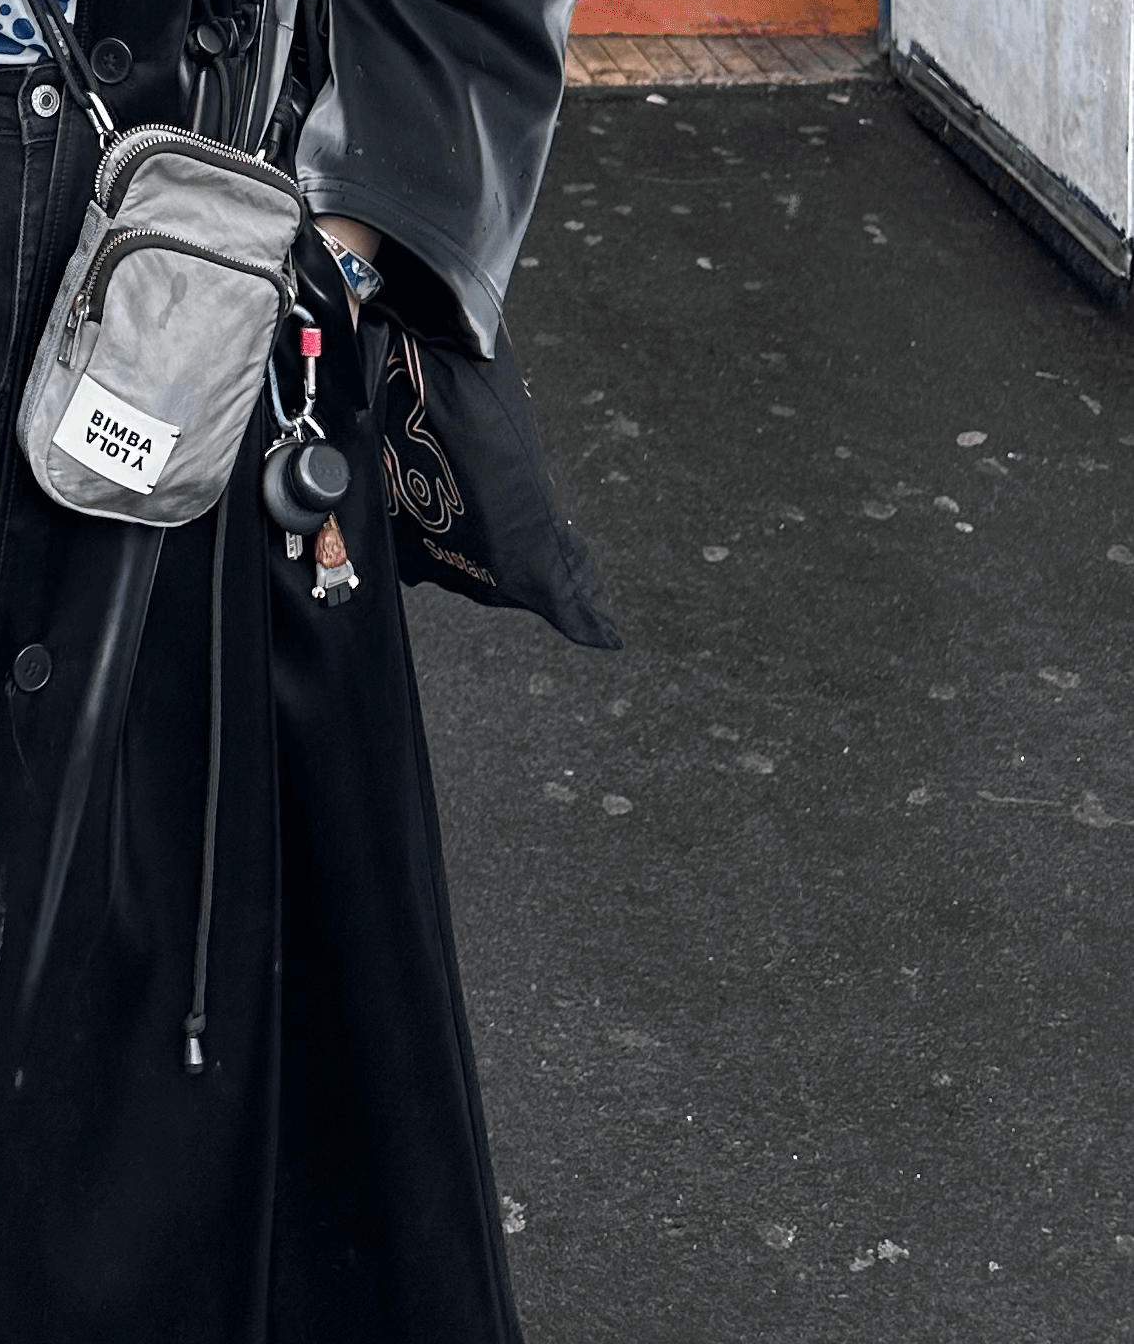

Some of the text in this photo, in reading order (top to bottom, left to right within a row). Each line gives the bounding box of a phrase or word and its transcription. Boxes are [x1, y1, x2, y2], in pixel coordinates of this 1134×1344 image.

[86, 426, 144, 471] Y LOLA
[90, 409, 152, 454] BIMBA
